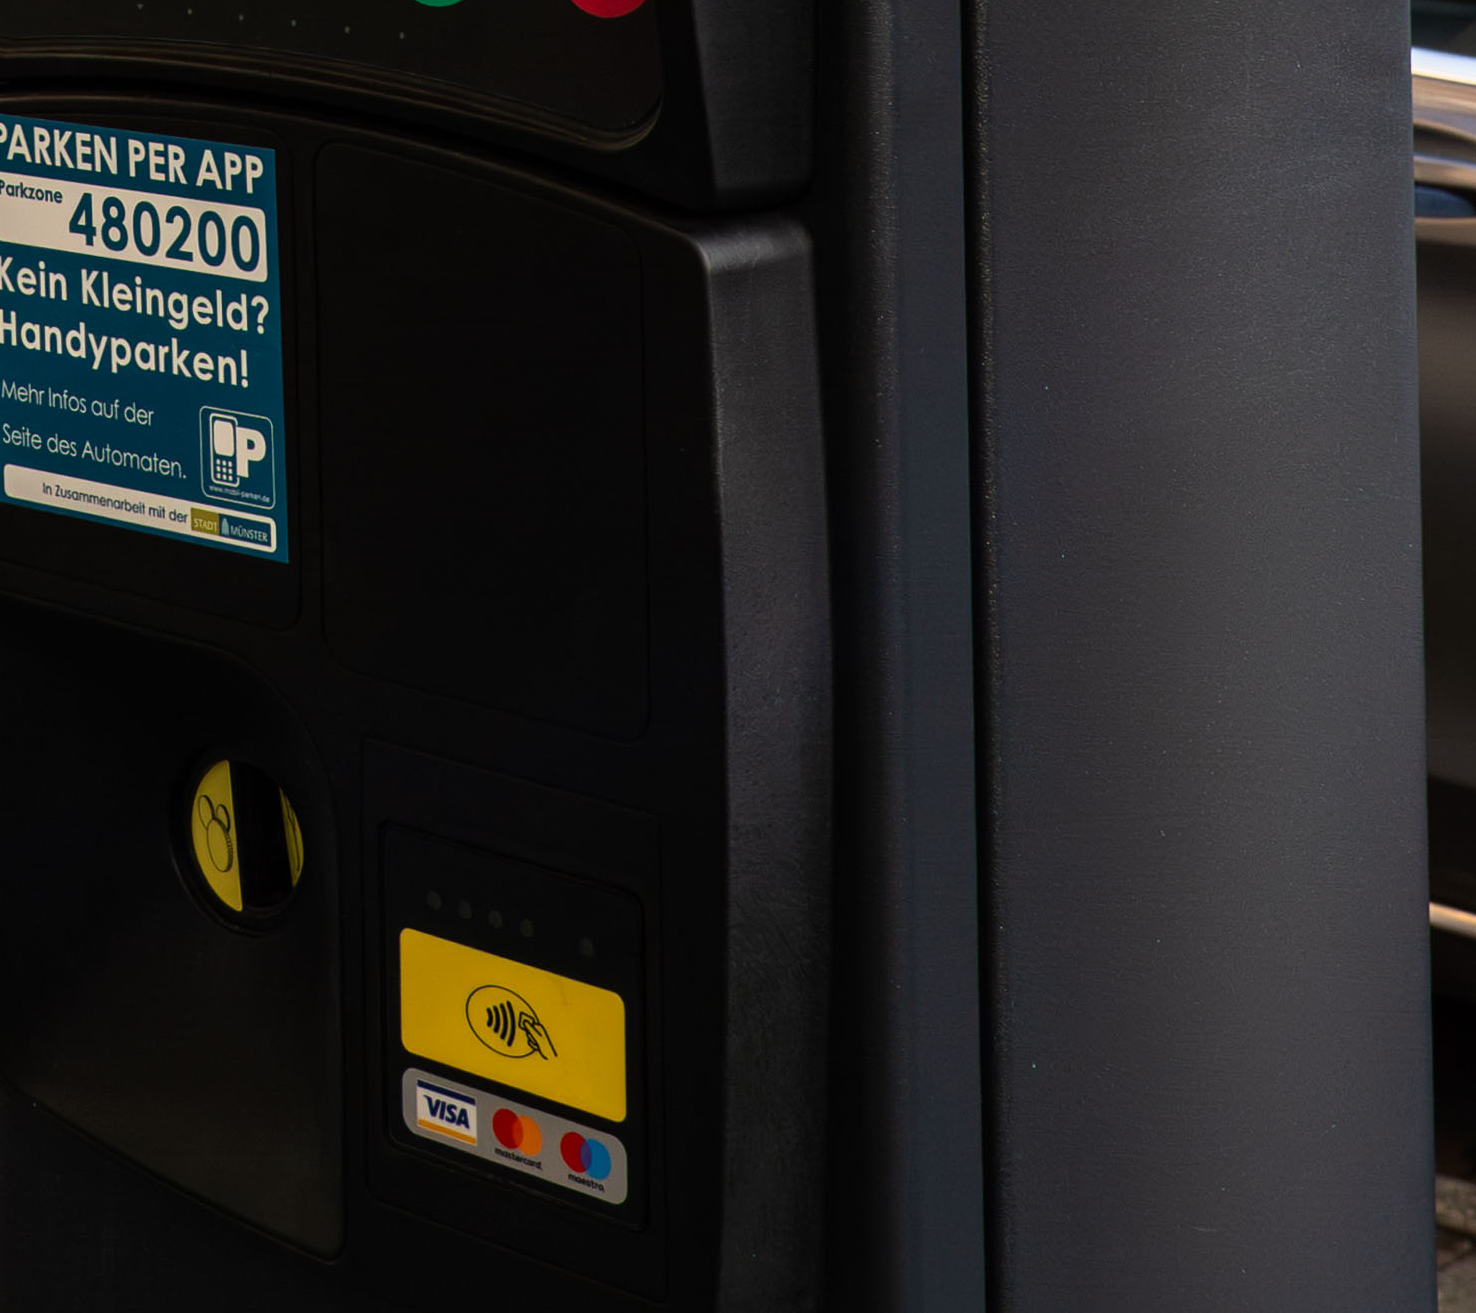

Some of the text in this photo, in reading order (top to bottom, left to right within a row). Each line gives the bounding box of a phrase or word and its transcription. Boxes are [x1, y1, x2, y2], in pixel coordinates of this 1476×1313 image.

[128, 139, 188, 185] PER
[196, 149, 264, 194] APP
[69, 192, 260, 273] 480200
[81, 268, 269, 335] Kleingeld?
[1, 379, 154, 426] Mehr Infos auf der
[2, 423, 187, 479] Seite des Automaten.
[42, 482, 188, 524] In Zusammenarbeit mit der
[194, 518, 268, 543] STADT MÜNSTER
[423, 1094, 470, 1129] VISA
